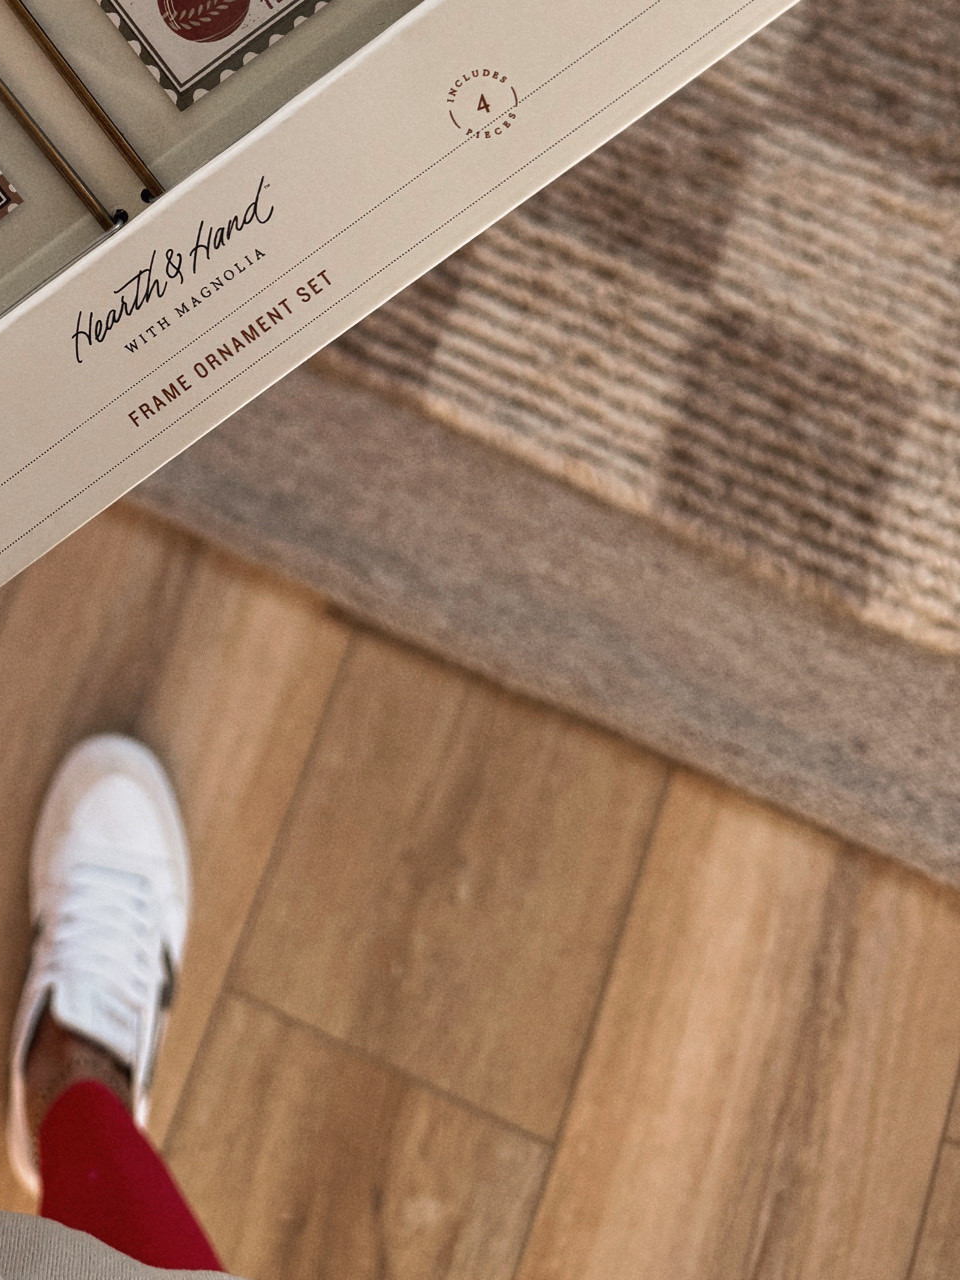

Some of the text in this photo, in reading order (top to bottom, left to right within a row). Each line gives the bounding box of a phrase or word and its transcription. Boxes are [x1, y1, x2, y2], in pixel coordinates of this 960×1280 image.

[446, 68, 508, 103] INCLUDES
[476, 93, 491, 113] 4
[465, 112, 517, 139] PIECES
[71, 250, 168, 364] Hearth
[165, 248, 183, 285] &
[123, 247, 266, 355] WITH MAGNOLIA
[127, 269, 335, 428] FRAME ORNAMENT SET
